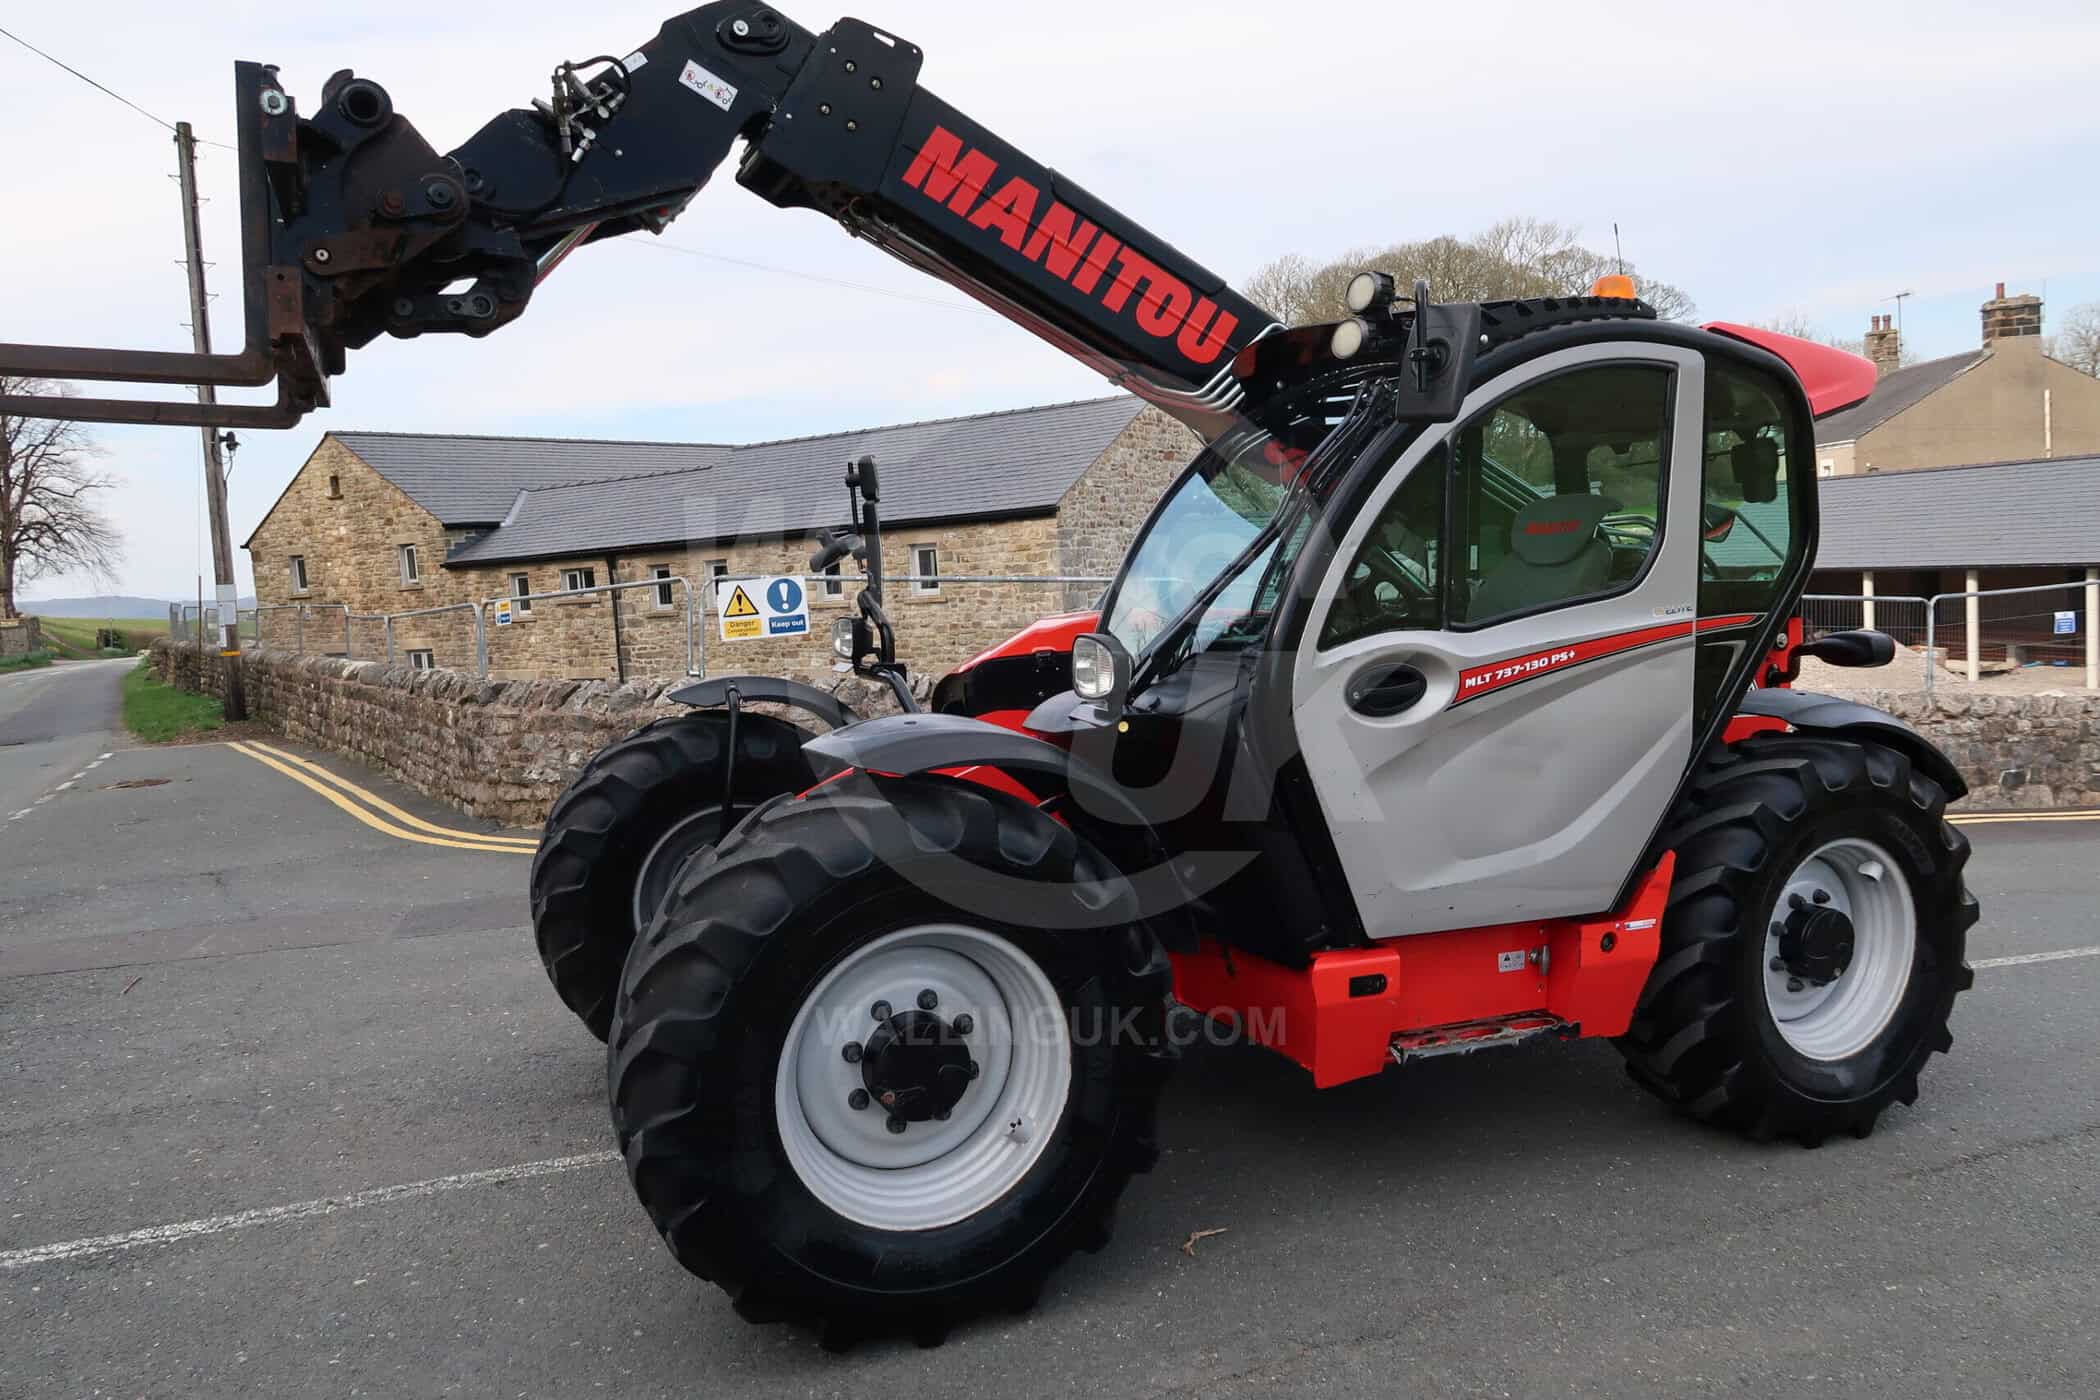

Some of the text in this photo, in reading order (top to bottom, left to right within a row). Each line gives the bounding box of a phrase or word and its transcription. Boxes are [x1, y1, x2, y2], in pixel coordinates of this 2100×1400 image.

[902, 125, 1239, 364] MANITOU
[771, 621, 791, 629] Keep
[1465, 650, 1576, 688] MLT 737-130 PS+
